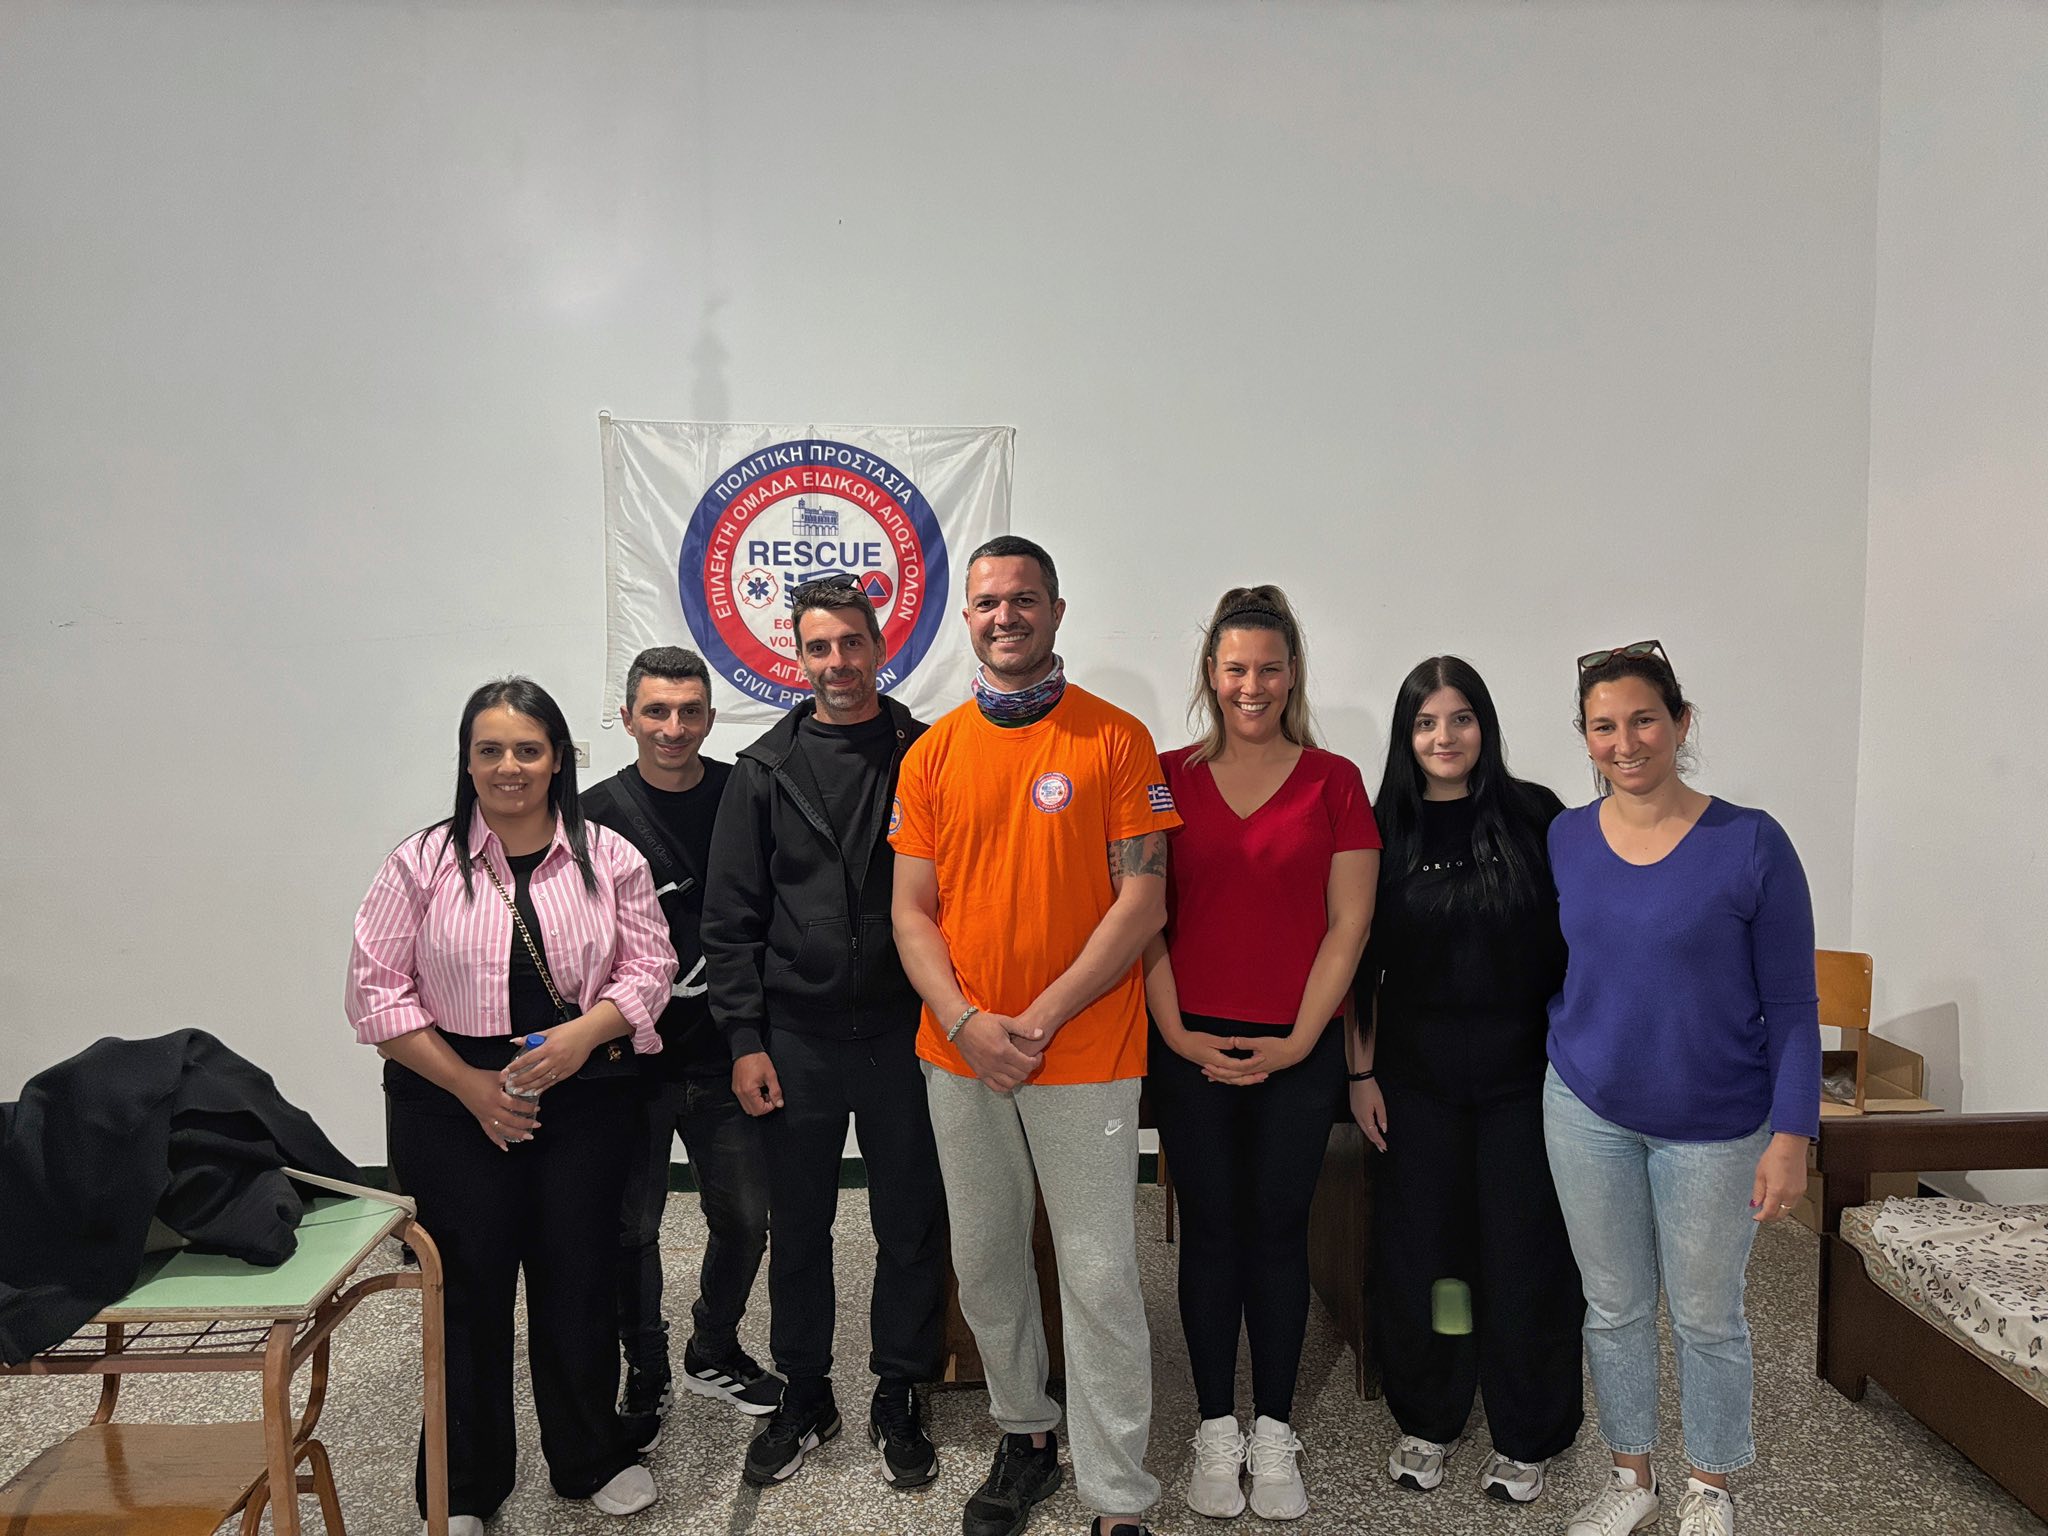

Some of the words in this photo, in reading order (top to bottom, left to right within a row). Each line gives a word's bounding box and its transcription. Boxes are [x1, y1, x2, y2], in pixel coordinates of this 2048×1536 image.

[715, 446, 803, 501] ΠΟΛΙΤΙΚΗ
[809, 445, 913, 505] ΠΡΟΣΤΑΣΙΑ
[710, 521, 738, 619] ΕΠΙΛΕΚΤΗ
[735, 475, 798, 521] ΟΜΑΔΑ
[802, 472, 881, 508] ΕΙΔΙΚΩΝ
[877, 505, 919, 621] ΑΠΟΣΤΟΛΩΝ
[748, 540, 882, 567] RESCUE
[733, 668, 774, 700] CIVIL
